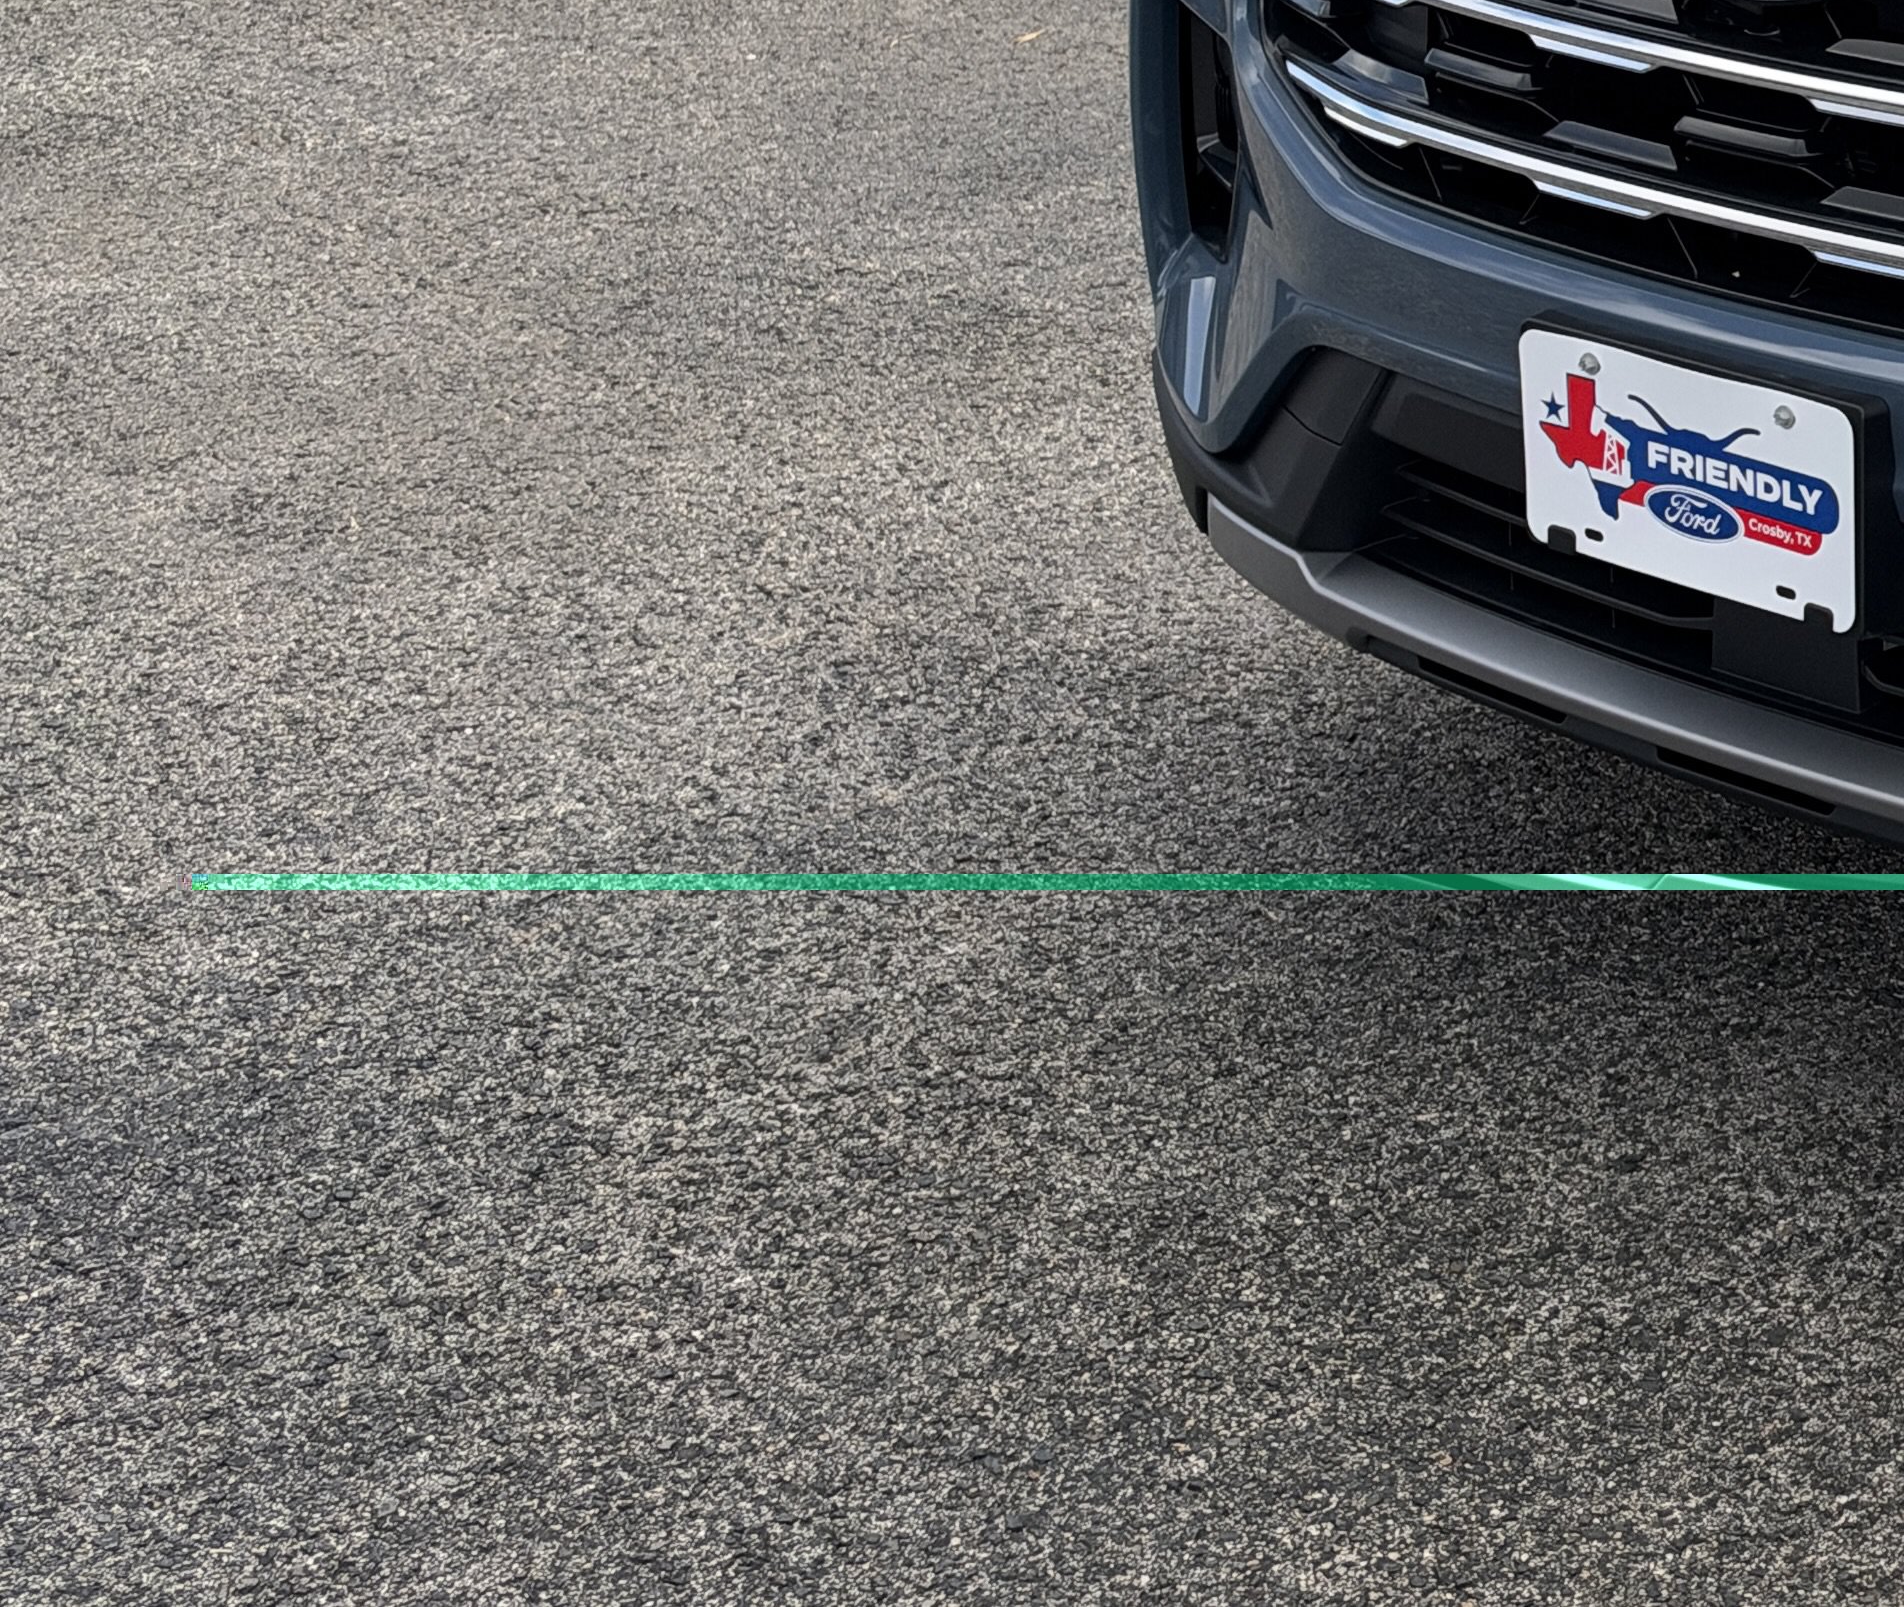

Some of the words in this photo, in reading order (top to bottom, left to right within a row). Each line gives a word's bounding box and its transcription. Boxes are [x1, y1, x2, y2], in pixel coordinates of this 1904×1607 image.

[1647, 440, 1823, 515] FRIENDLY
[1664, 494, 1722, 536] Ford
[1795, 531, 1813, 548] TX
